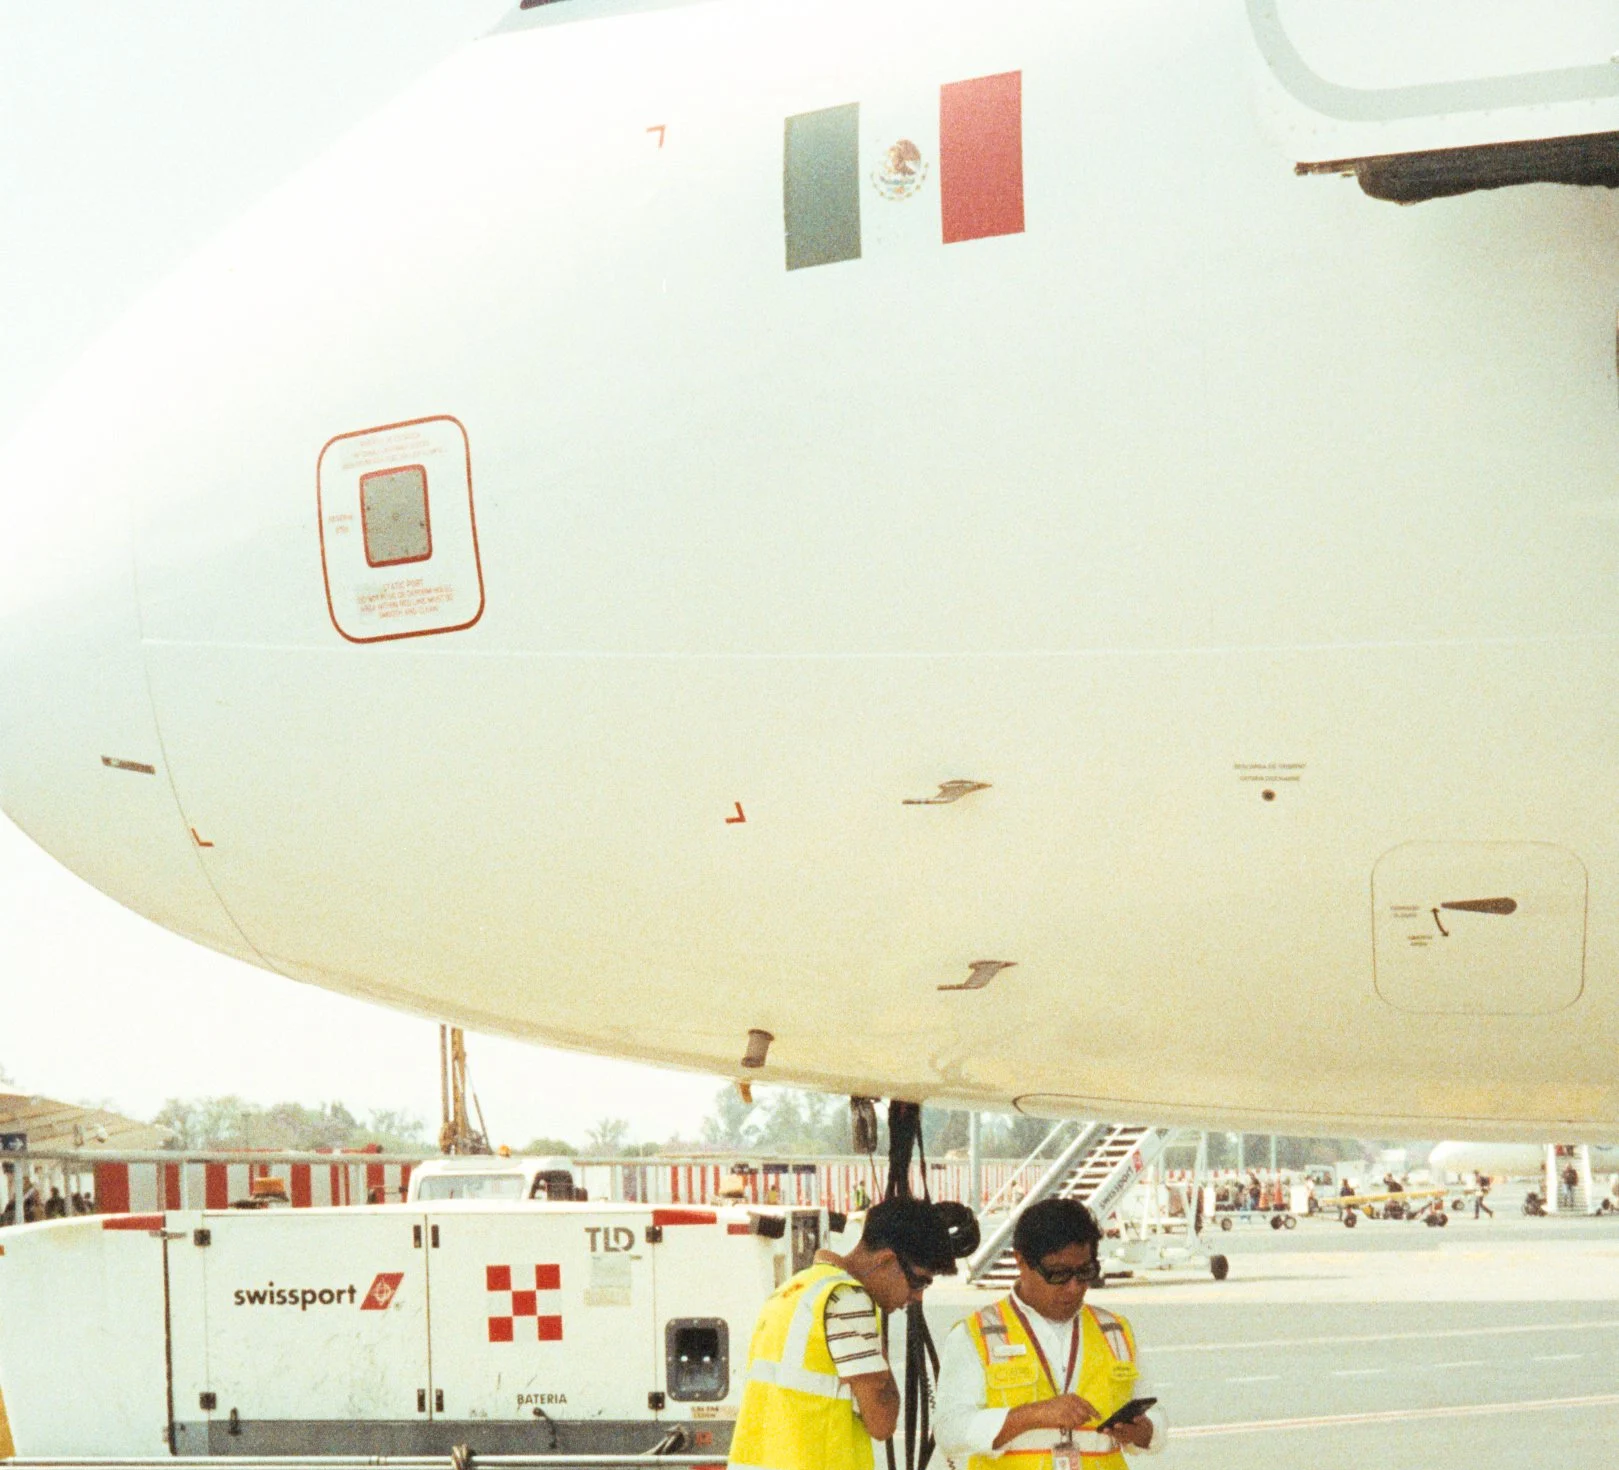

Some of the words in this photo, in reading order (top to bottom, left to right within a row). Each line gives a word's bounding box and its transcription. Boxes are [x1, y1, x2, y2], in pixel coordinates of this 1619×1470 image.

[584, 1226, 636, 1253] TLD
[233, 1281, 357, 1311] swissport
[516, 1393, 568, 1405] BATERIA
